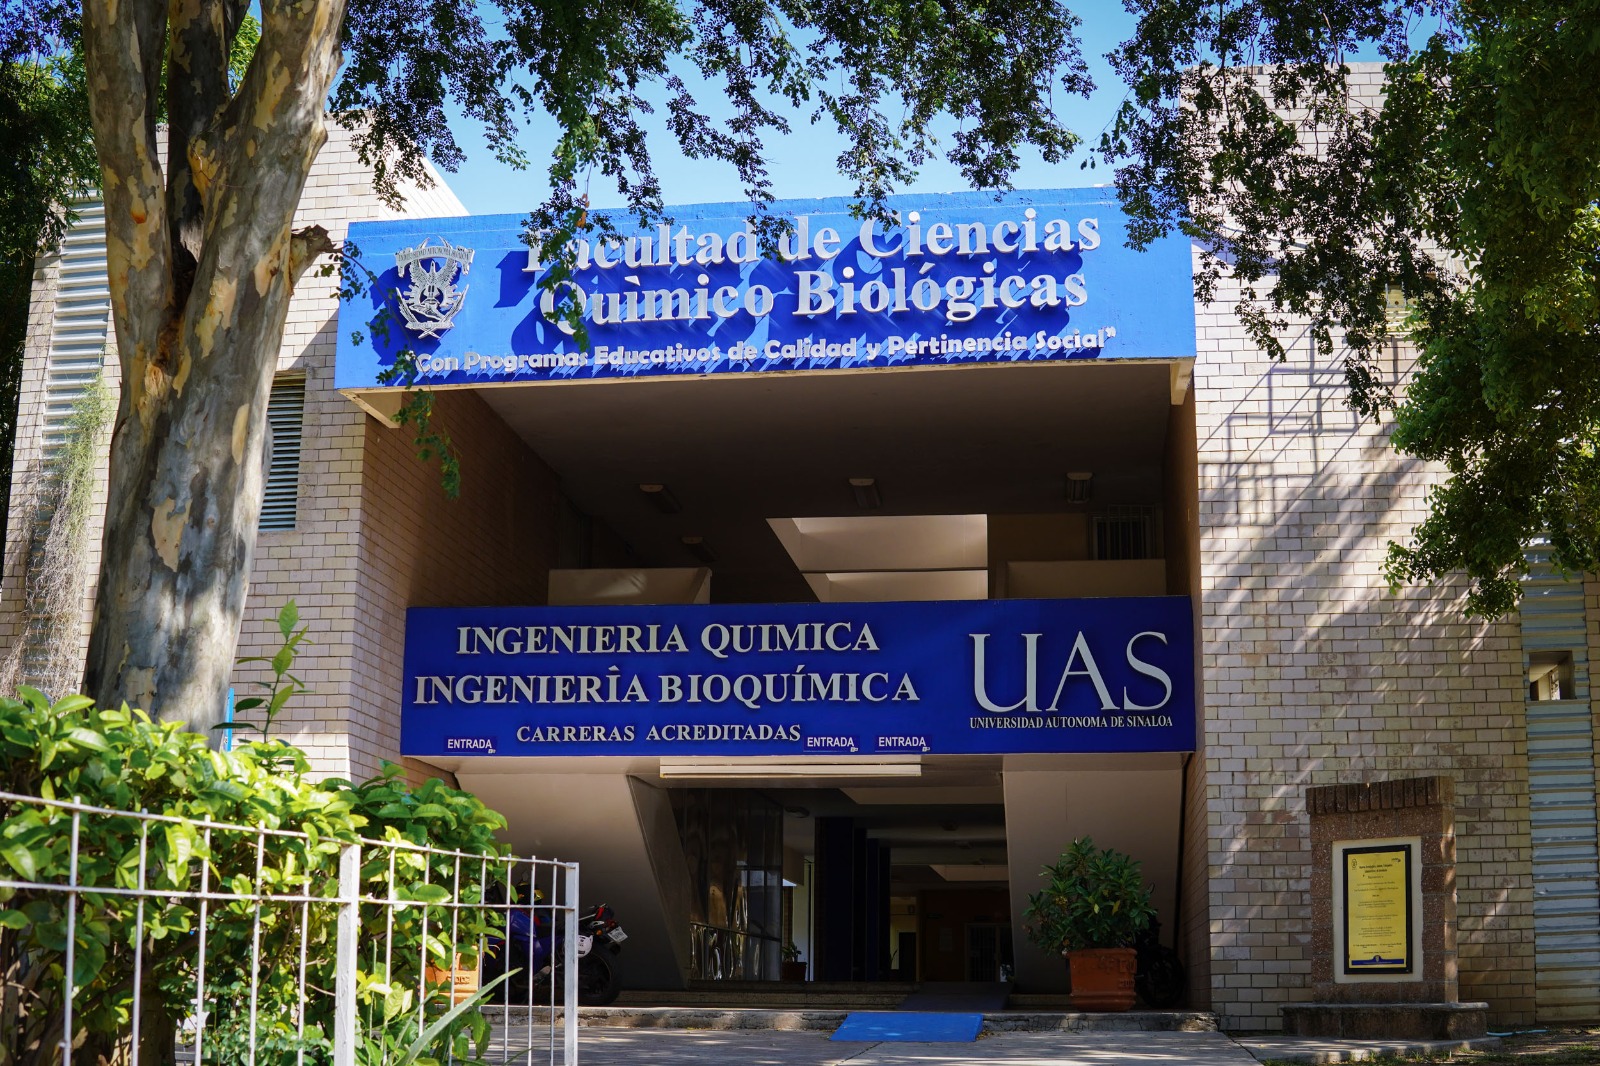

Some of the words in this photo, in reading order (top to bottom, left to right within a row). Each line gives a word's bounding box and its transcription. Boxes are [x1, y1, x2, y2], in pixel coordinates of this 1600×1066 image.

[521, 221, 761, 273] Facultad
[777, 215, 841, 264] de
[857, 207, 1101, 260] Ciencias
[792, 261, 1088, 323] Biológicas
[463, 351, 588, 373] Programas
[593, 343, 721, 366] Educativos
[727, 340, 758, 362] de
[763, 337, 858, 361] Calidad
[865, 343, 882, 362] y
[887, 331, 1029, 358] Pertinencia
[456, 624, 689, 655] INGENIERIA
[701, 621, 880, 659] QUIMICA
[657, 665, 920, 709] BIOQUÍMICA
[968, 630, 1173, 713] UAS
[516, 725, 636, 743] CARRERAS
[645, 724, 801, 742] ACREDITADAS
[878, 735, 927, 747] ENTRADA
[969, 716, 1043, 729] UNIVERSIDAD
[1045, 716, 1108, 728] AUTONOMA
[1110, 716, 1124, 728] DE
[1126, 715, 1173, 728] SINALOA
[447, 738, 493, 749] ENTRADA
[806, 736, 855, 747] ENTRADA
